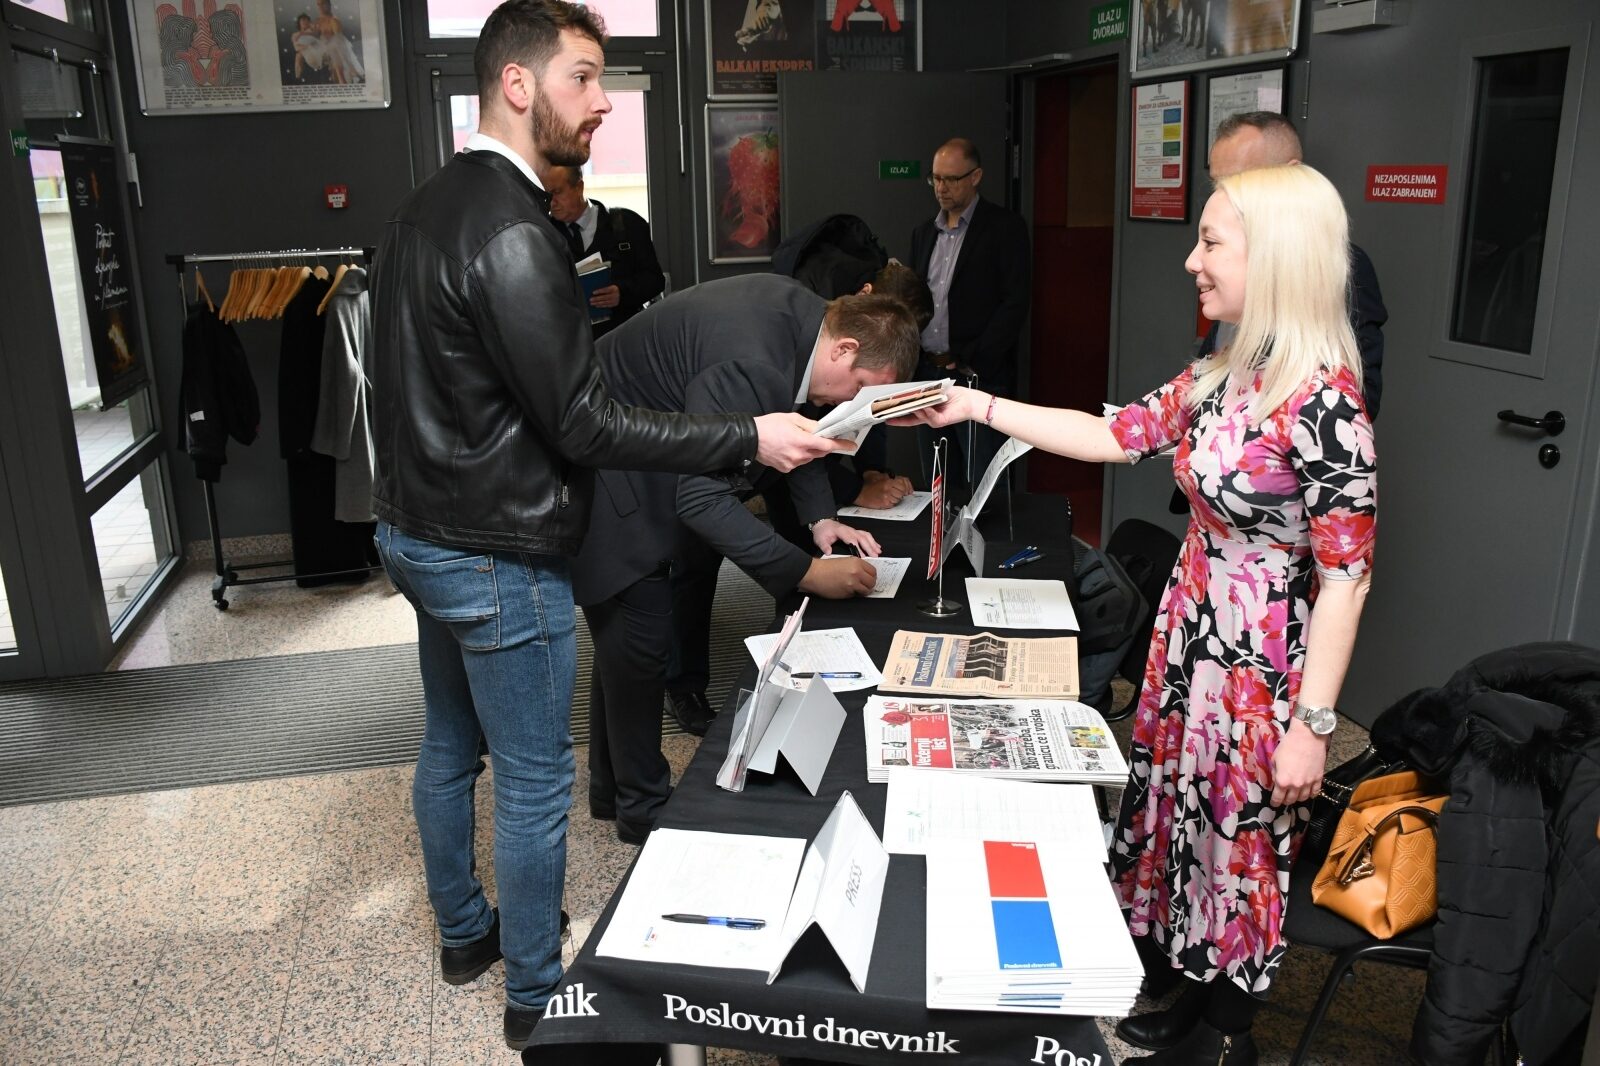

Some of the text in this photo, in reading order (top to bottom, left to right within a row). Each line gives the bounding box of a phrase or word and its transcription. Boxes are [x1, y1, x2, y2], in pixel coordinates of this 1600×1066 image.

[1097, 8, 1122, 24] ULAZ U
[1092, 22, 1125, 40] DVORANU
[716, 60, 814, 72] BALKAN EKSPRES
[890, 166, 910, 174] IZLAZ
[1374, 174, 1437, 184] NEZAPOSLENIMA
[1372, 187, 1437, 198] ULAZ ZABRANJEN!
[914, 639, 938, 682] Poslovni dnevnik
[1029, 709, 1045, 732] vojska
[930, 738, 947, 750] list
[1019, 718, 1040, 769] Ako zatreba, na
[1035, 736, 1048, 744] će
[1037, 745, 1060, 770] granicu
[845, 859, 862, 908] PRESS
[662, 993, 961, 1054] Poslovni dnevnik
